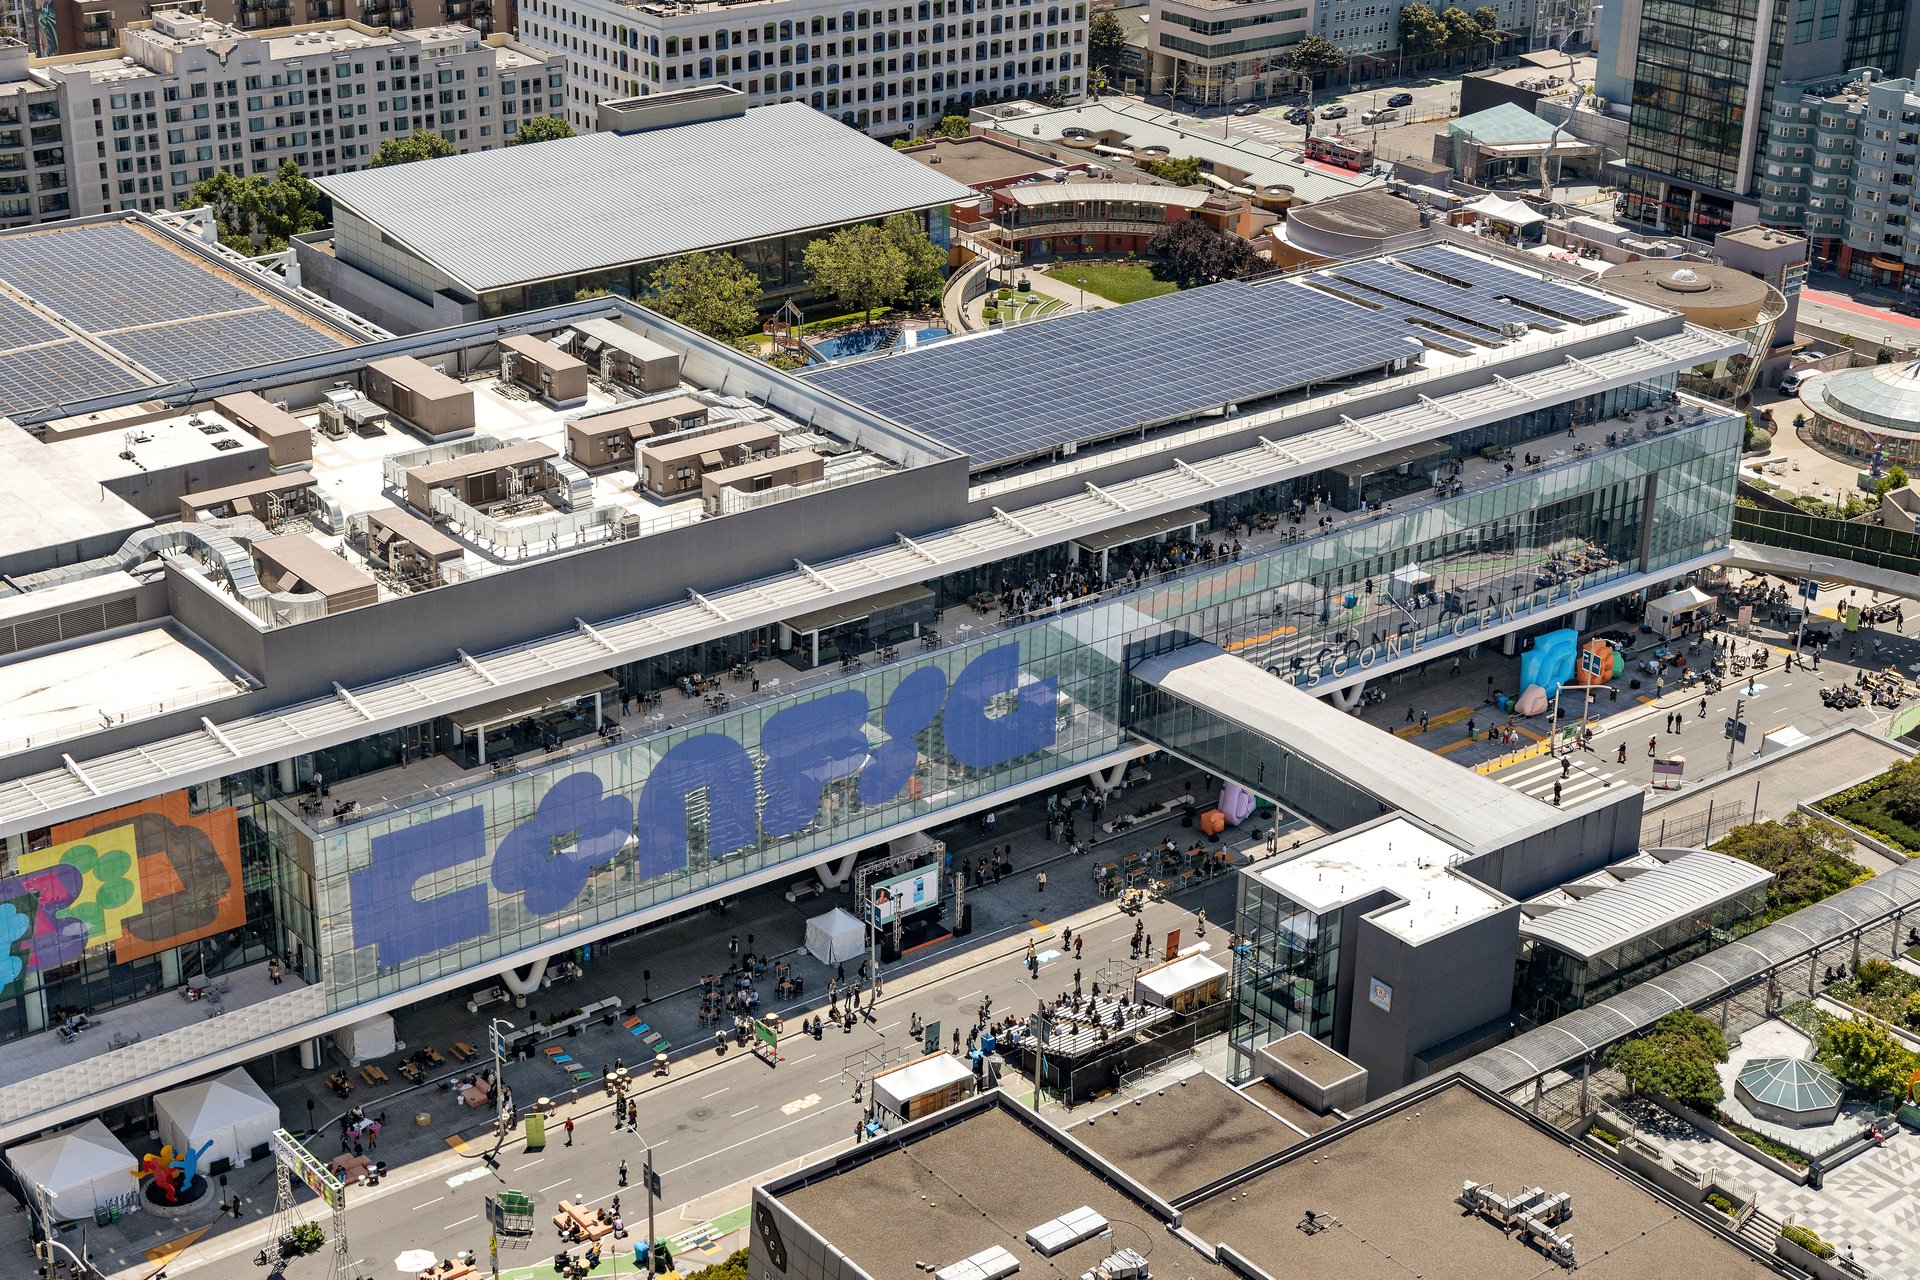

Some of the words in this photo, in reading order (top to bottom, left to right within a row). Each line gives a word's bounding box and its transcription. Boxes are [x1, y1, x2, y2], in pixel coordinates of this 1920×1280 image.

[1281, 629, 1425, 687] OSCONE
[1453, 578, 1582, 637] CENTER
[758, 1211, 781, 1265] YBCA
